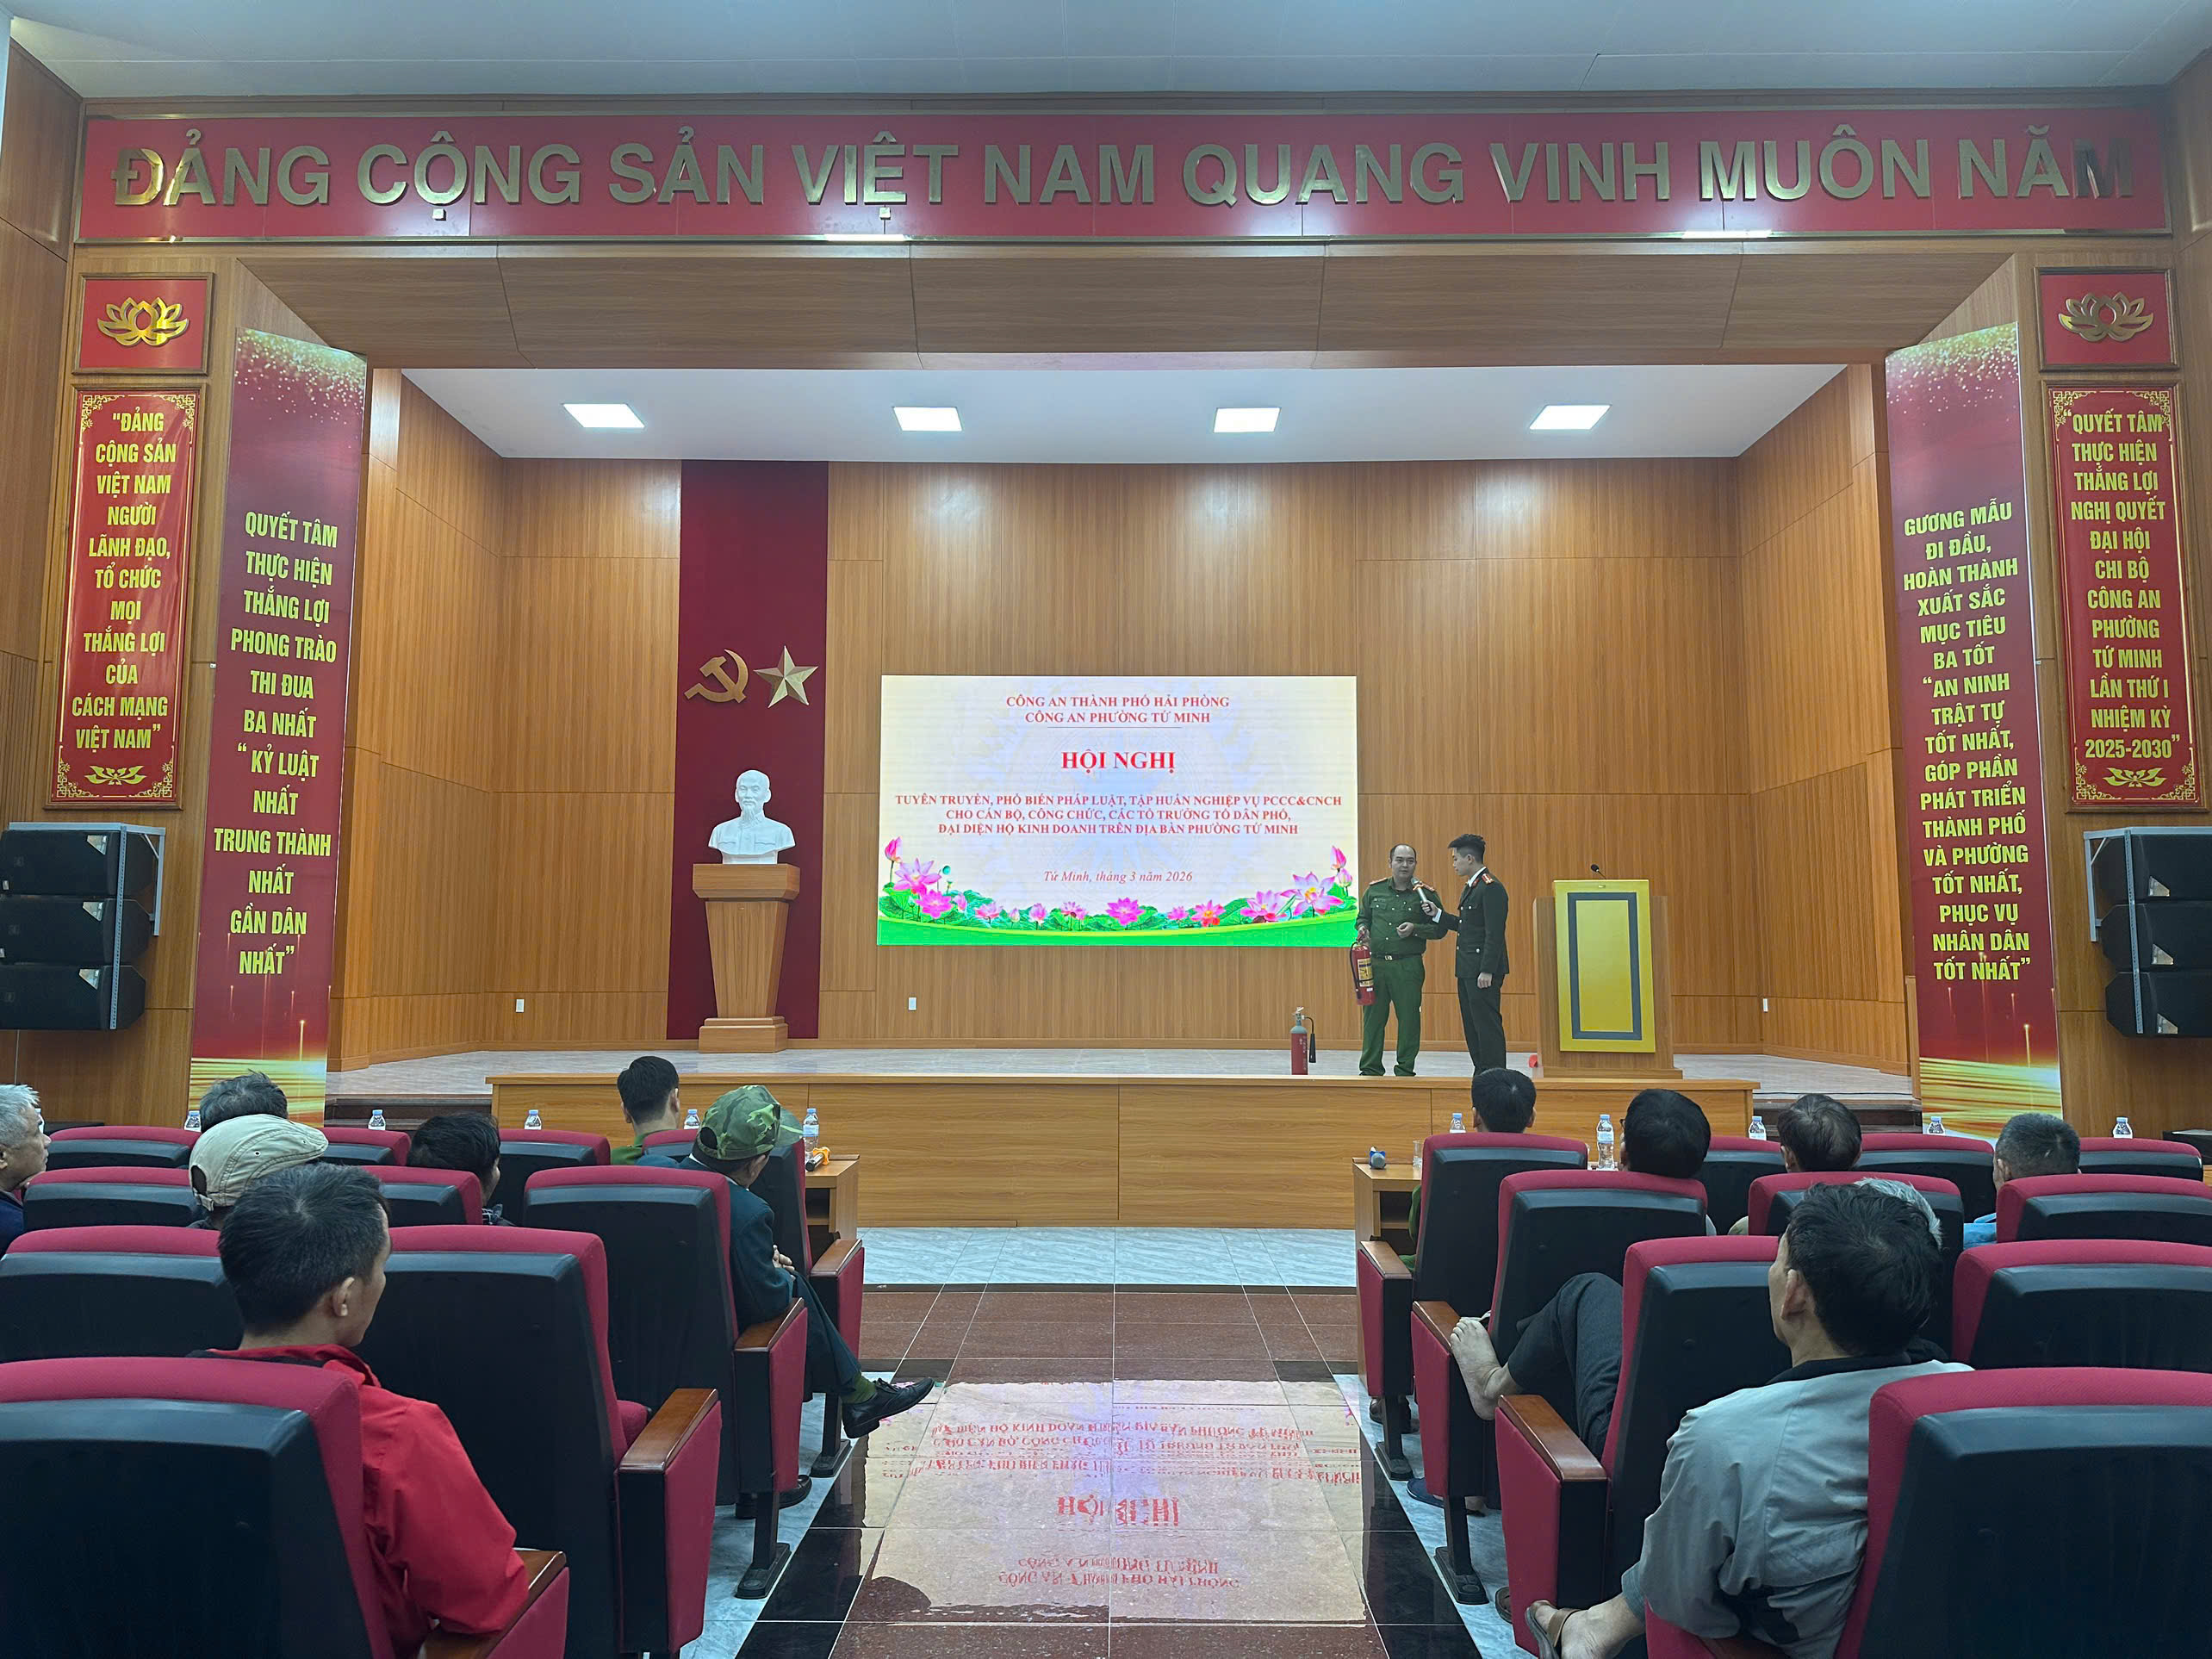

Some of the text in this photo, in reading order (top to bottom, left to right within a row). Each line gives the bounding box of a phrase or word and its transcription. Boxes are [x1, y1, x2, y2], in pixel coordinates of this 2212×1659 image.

[111, 124, 2134, 220] ĐẢNG CỘNG SẢN VIỆT NAM QUANG VINH MUÔN NĂM
[2127, 410, 2162, 432] TÂM
[96, 438, 176, 466] CỘNG SẢN
[2072, 440, 2157, 466] THỰC HIỆN
[97, 472, 171, 498] VIỆT NAM
[2134, 470, 2159, 495] LỢI
[108, 502, 156, 525] NGƯỜI
[1904, 497, 2012, 537] GƯƠNG MẪU
[2071, 496, 2165, 523] NGHỊ QUYẾT
[245, 510, 338, 549] QUYẾT TÂM
[2090, 527, 2150, 553] ĐẠI HỘI
[89, 534, 171, 562] LÃNH ĐẠO,
[1925, 531, 1991, 560] ĐI ĐẦU,
[96, 562, 161, 589] TỔ CHỨC
[246, 550, 332, 589] THỰC HIỆN
[1904, 558, 2018, 592] HOÀN THÀNH
[2095, 557, 2149, 583] CHI BỘ
[244, 584, 330, 628] THẮNG LỢI
[1917, 584, 2006, 617] XUẤT SẮC
[2088, 587, 2160, 609] CÔNG AN
[111, 600, 140, 624] MỌI
[1920, 616, 2006, 648] MỤC TIÊU
[2092, 616, 2159, 638] PHƯỜNG
[84, 627, 165, 656] THẮNG LỢI
[231, 627, 337, 662] PHONG TRÀO
[1933, 640, 1996, 670] BA TỐT
[106, 658, 138, 684] CỦA
[2093, 647, 2162, 668] TỨ MINH
[251, 670, 314, 699] THI ĐUA
[1964, 672, 2010, 694] NINH
[2090, 672, 2168, 699] LẦN THỨ I
[72, 693, 168, 722] CÁCH MẠNG
[1007, 694, 1045, 706] CÔNG
[1049, 697, 1066, 706] AN
[1071, 694, 1117, 706] THÀNH
[1154, 694, 1177, 706] HẢI
[1182, 694, 1229, 706] PHÒNG
[244, 707, 317, 738] BA NHẤT
[1025, 710, 1210, 723] CÔNG AN PHƯỜNG TỨ MINH
[1932, 699, 2004, 730] TRẬT TỰ
[2091, 705, 2171, 732] NHIỆM KỲ
[76, 725, 109, 753] VIỆT
[1925, 725, 2015, 755] TỐT NHẤT,
[278, 749, 319, 782] LUẬT
[1061, 749, 1176, 774] HỘI NGHỊ
[1924, 754, 2018, 781] GÓP PHẦN
[252, 785, 298, 816] NHẤT
[896, 793, 936, 805] TUYÊN
[1057, 794, 1088, 805] PHÁP
[1193, 794, 1240, 807] NGHIỆP
[1243, 796, 1259, 807] VỤ
[1264, 796, 1341, 805] PCCC&CNCH
[1920, 780, 2026, 811] PHÁT TRIỂN
[947, 810, 972, 818] CHO
[977, 808, 1001, 818] CÁN
[1005, 810, 1024, 821] BỘ,
[1028, 808, 1063, 819] CÔNG
[1067, 809, 1106, 821] CHỨC,
[1109, 808, 1134, 819] CÁC
[1233, 808, 1259, 819] DÂN
[1923, 809, 2027, 838] THÀNH PHỐ
[214, 828, 331, 857] TRUNG THÀNH
[939, 823, 1297, 836] ĐẠI DIỆN HỘ KINH DOANH TRÊN ĐỊA BÀN PHƯỜNG TỨ MINH
[1923, 842, 2029, 866] VÀ PHƯỜNG
[248, 861, 294, 895] NHẤT
[1044, 871, 1193, 884] Tứ Minh, tháng 3 năm 2026
[1932, 867, 2022, 895] TỐT NHẤT,
[230, 901, 307, 935] GẦN DÂN
[1939, 904, 2019, 927] PHỤC VỤ
[1933, 926, 2029, 952] NHÂN DÂN
[1934, 955, 1968, 981] TỐT
